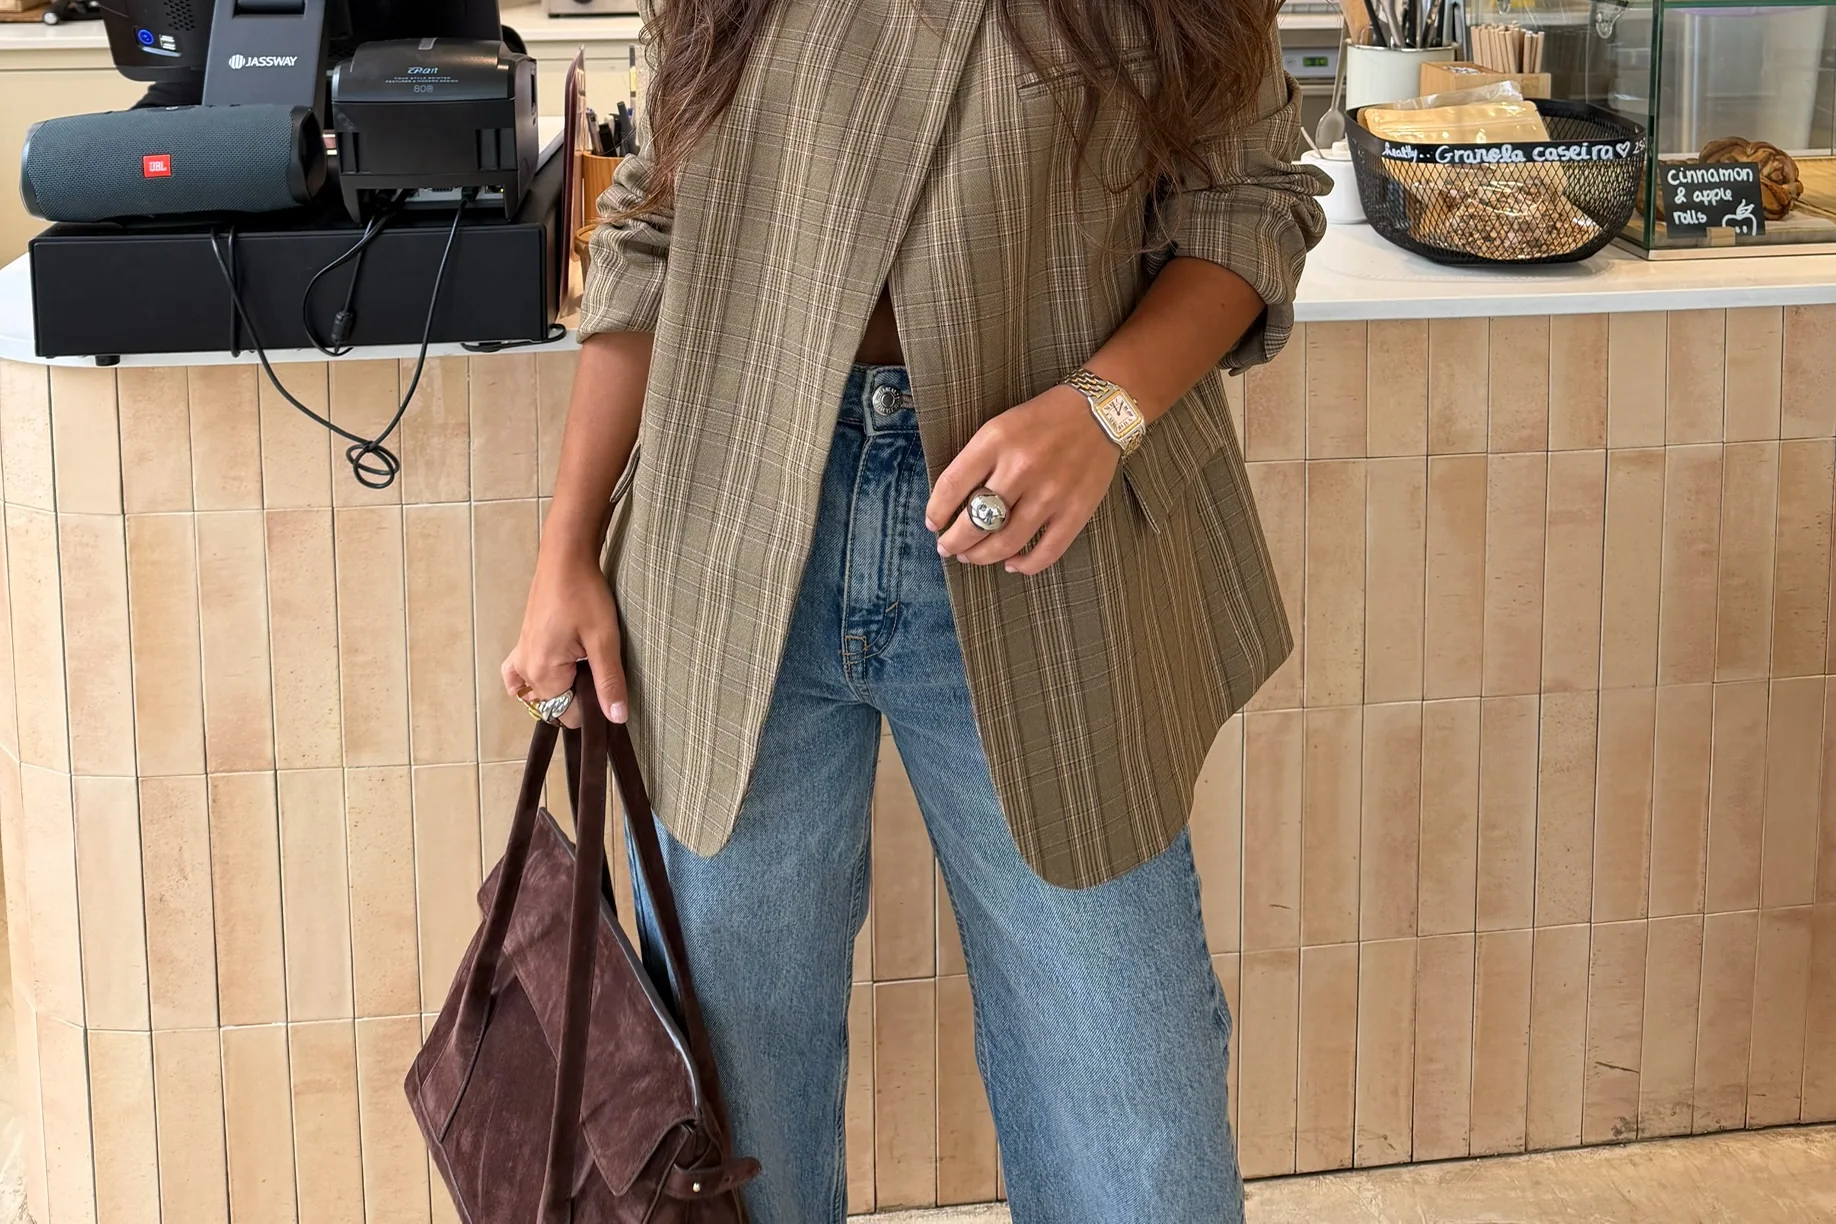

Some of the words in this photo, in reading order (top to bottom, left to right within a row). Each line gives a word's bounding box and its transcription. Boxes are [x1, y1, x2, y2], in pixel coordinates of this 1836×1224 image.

[245, 56, 298, 68] JASSWAY
[1435, 143, 1526, 164] Granola
[1526, 143, 1613, 162] caseira
[149, 161, 167, 172] JBL
[1674, 186, 1687, 204] &
[1693, 187, 1733, 206] apple
[1672, 209, 1707, 225] rolls
